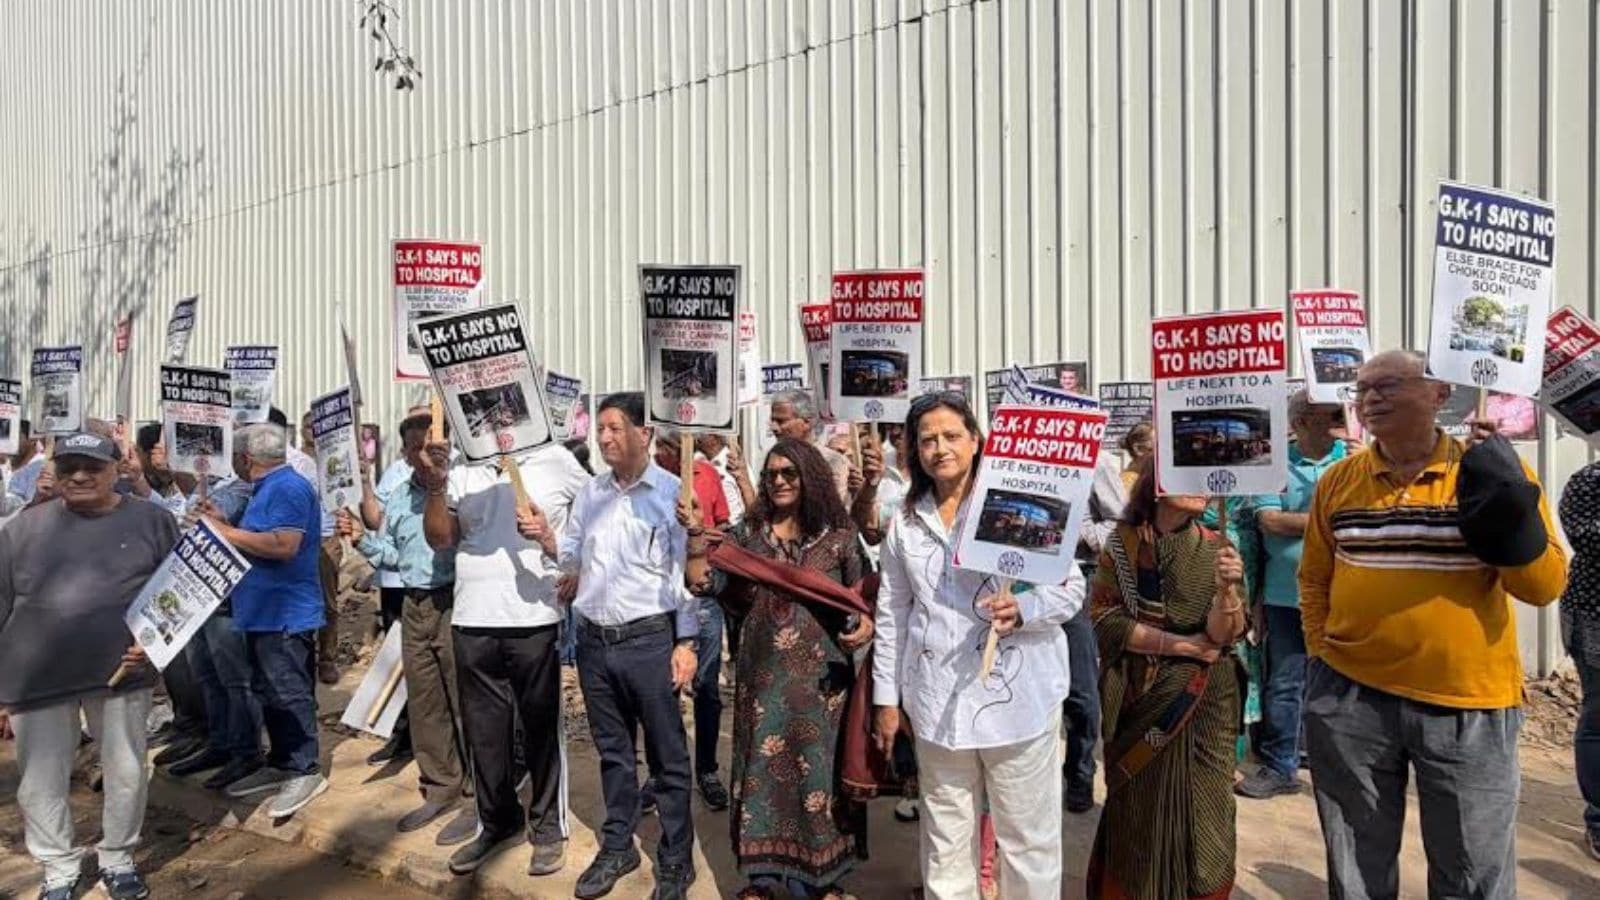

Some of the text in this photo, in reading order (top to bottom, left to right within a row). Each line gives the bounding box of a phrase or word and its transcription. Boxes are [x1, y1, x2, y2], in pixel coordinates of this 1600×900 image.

[1440, 194, 1555, 237] G.K-1 SAYS NO
[1443, 220, 1550, 263] TO HOSPITAL
[396, 249, 480, 268] G.K-1 SAYS NO
[1446, 251, 1542, 279] ELSE BRACE FOR
[398, 266, 477, 284] TO HOSPITAL
[644, 275, 735, 296] G.K-1 SAYS NO
[1448, 262, 1538, 291] CHOKED ROADS
[832, 280, 923, 299] G.K-1 SAYS NO
[1471, 280, 1506, 297] SOON
[647, 297, 730, 317] TO HOSPITAL
[835, 301, 918, 319] TO HOSPITAL
[1294, 296, 1321, 309] G.K-1
[1324, 296, 1348, 310] SAYS
[1298, 311, 1364, 325] TO HOSPITAL
[1554, 315, 1580, 337] NO
[421, 311, 519, 348] G.K-1 SAYS NO
[862, 324, 888, 334] NEXT
[890, 324, 904, 334] TO
[1154, 319, 1284, 350] G.K-1 SAYS NO
[430, 332, 521, 365] TO HOSPITAL
[1160, 344, 1280, 373] TO HOSPITAL
[162, 370, 188, 386] G.K-1
[191, 374, 217, 389] SAYS
[218, 378, 232, 391] NO
[1167, 377, 1195, 392] LIFE
[1199, 375, 1236, 390] NEXT
[1240, 374, 1259, 388] TO
[1262, 373, 1273, 386] A
[165, 386, 230, 406] TO HOSPITAL
[1186, 393, 1253, 408] HOSPITAL
[991, 416, 1032, 433] G.K-1
[1034, 418, 1077, 438] SAYS
[1079, 421, 1105, 440] NO
[992, 435, 1012, 454] TO
[1014, 437, 1093, 463] HOSPITAL
[991, 459, 1081, 480] LIFE NEXT TO A
[1001, 477, 1060, 495] HOSPITAL
[178, 538, 195, 559] TO
[187, 550, 229, 597] HOSPITAL
[206, 544, 232, 573] SAYS
[225, 564, 242, 585] NO
